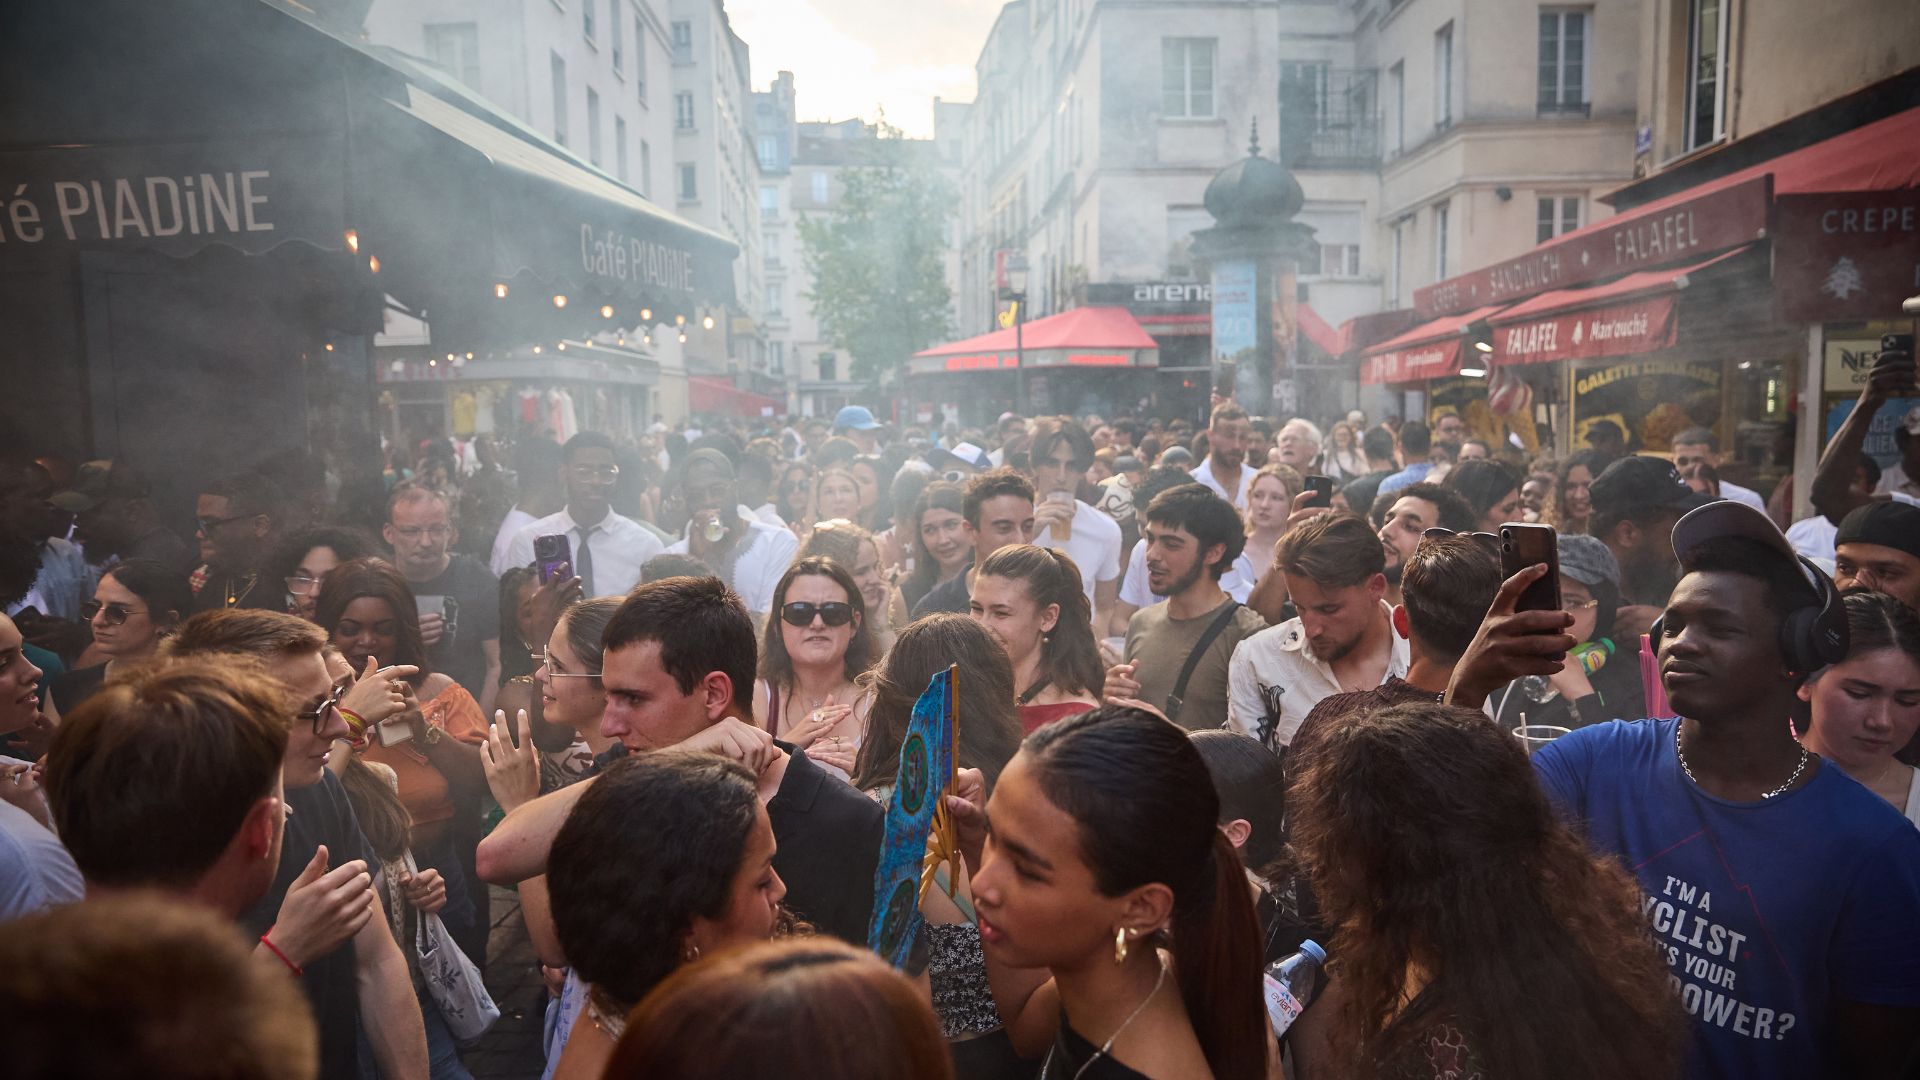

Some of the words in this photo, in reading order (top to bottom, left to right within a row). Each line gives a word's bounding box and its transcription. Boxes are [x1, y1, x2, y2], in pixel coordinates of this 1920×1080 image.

[54, 170, 275, 240] PIADiNE
[1822, 207, 1915, 234] CREPE
[581, 223, 627, 280] Café
[1490, 252, 1562, 297] SANDWICH
[1614, 210, 1699, 264] FALAFEL
[1506, 322, 1559, 356] FALAFEL
[1662, 875, 1698, 905] I'M
[1697, 891, 1712, 913] A
[1685, 952, 1737, 991] YOUR
[1271, 992, 1292, 1015] evian
